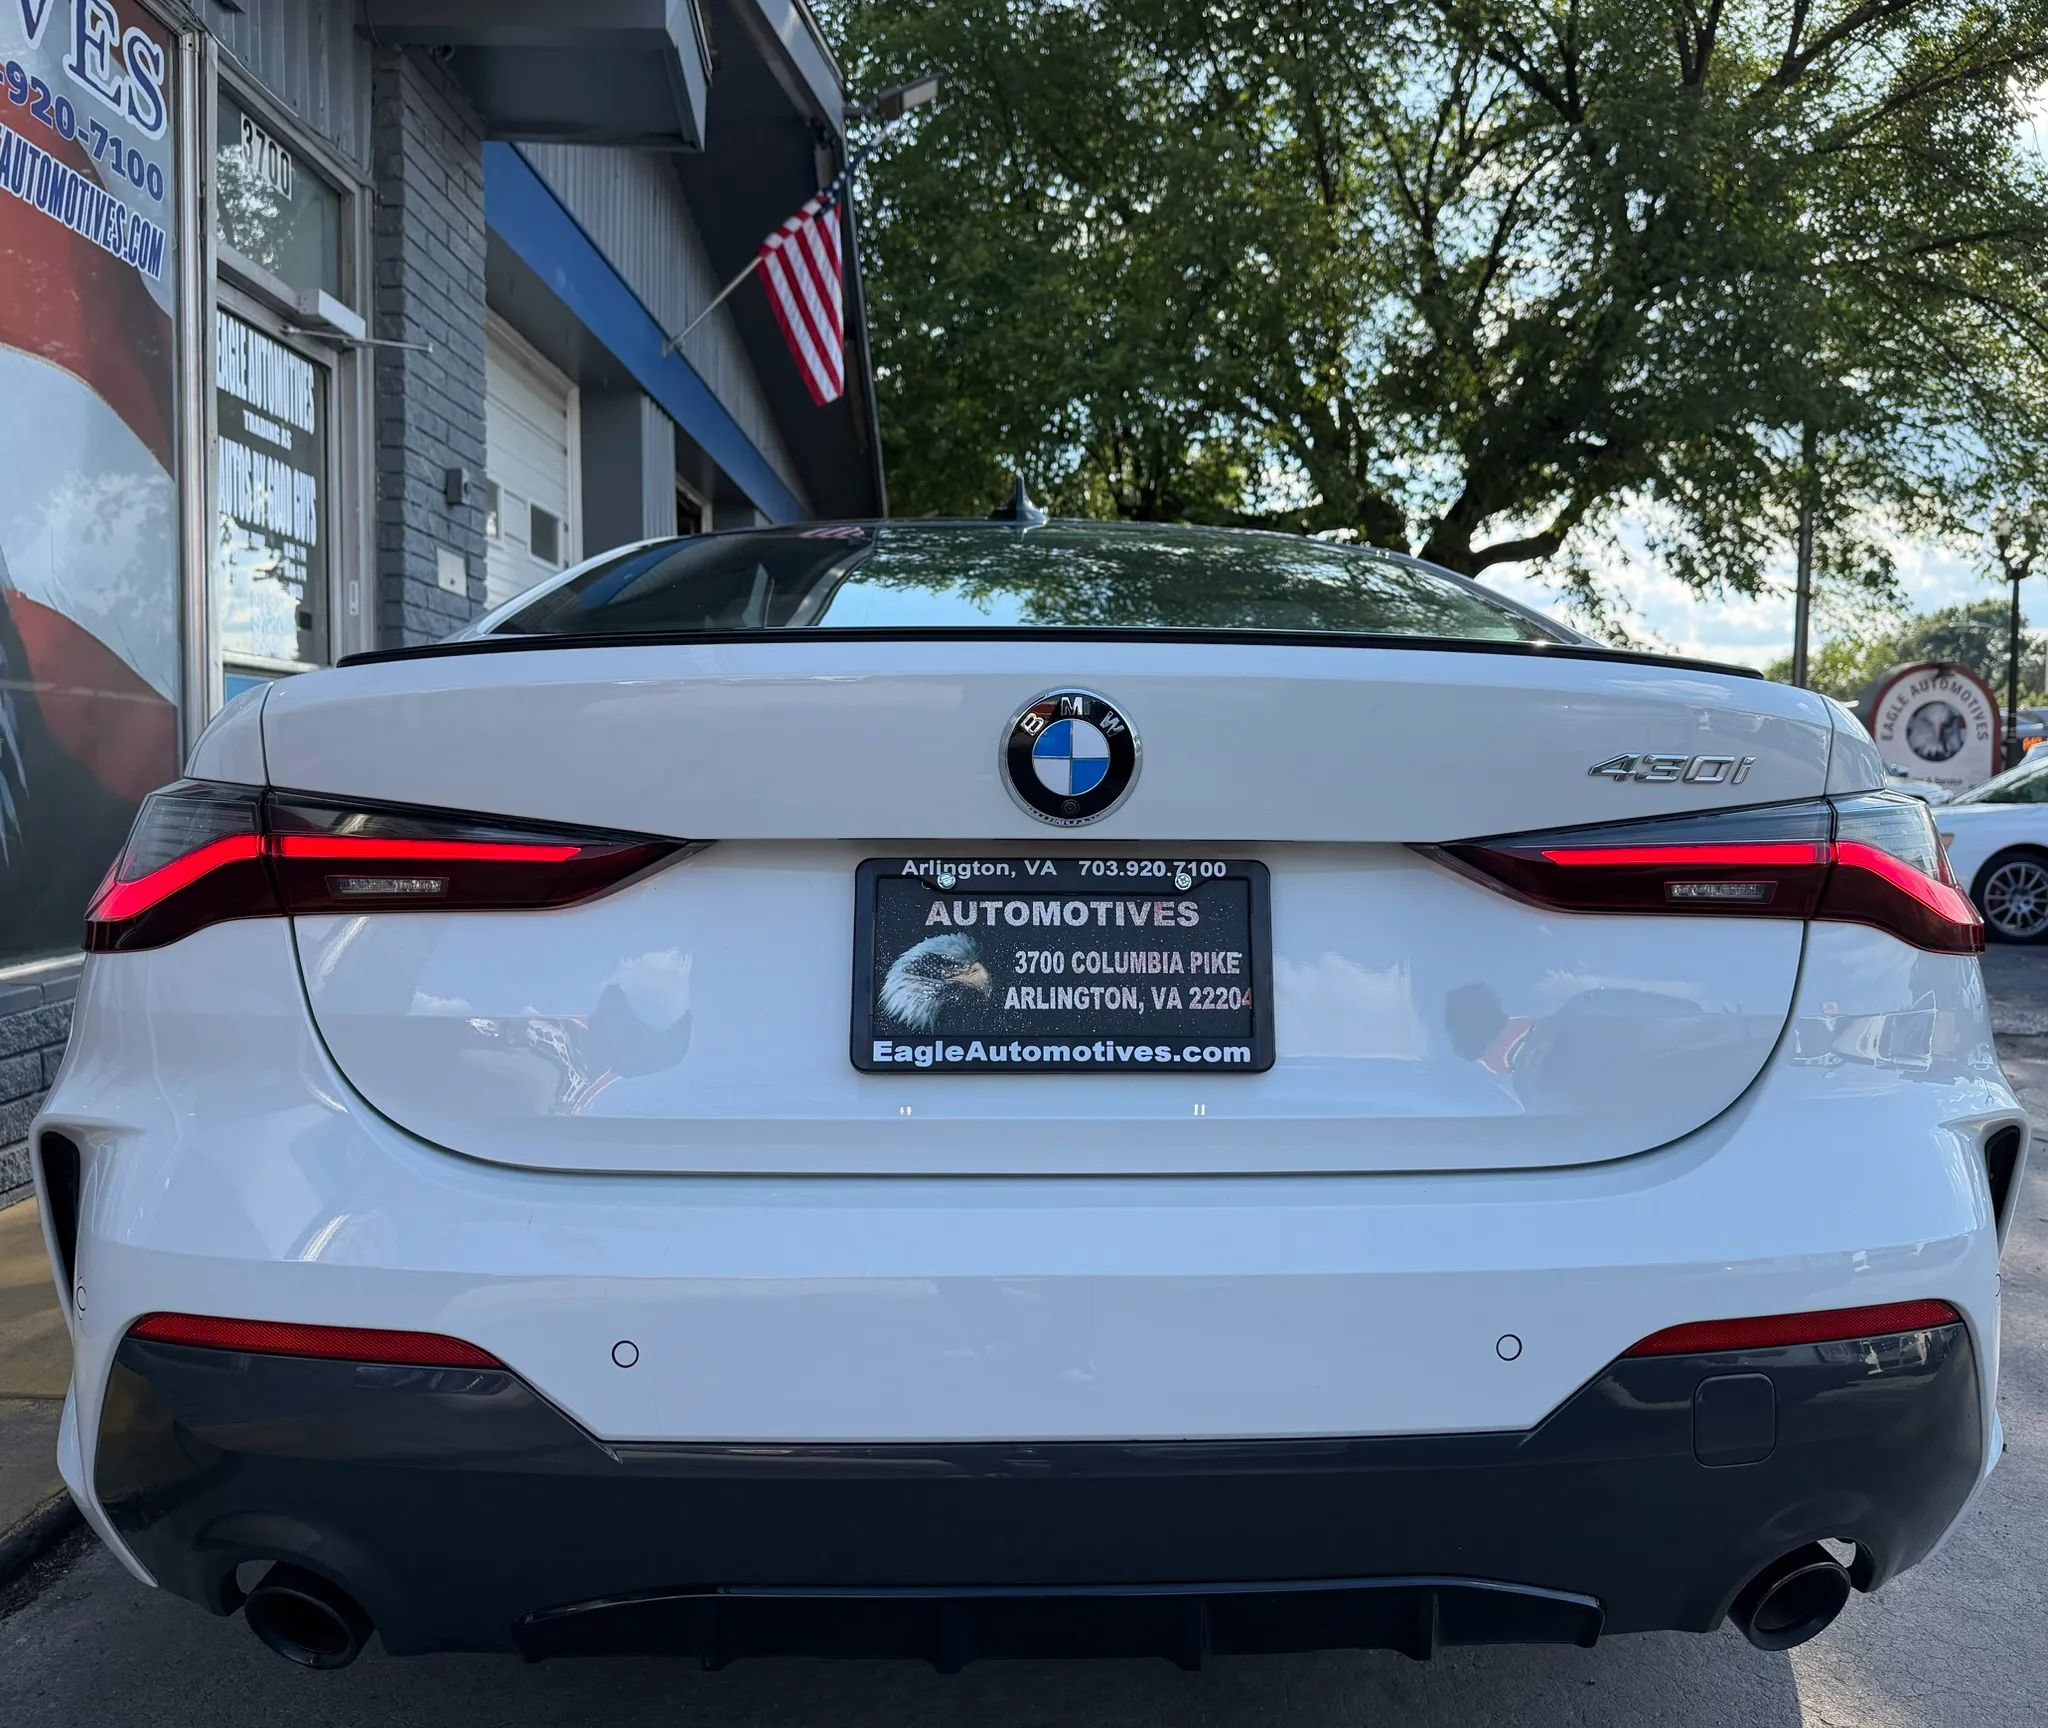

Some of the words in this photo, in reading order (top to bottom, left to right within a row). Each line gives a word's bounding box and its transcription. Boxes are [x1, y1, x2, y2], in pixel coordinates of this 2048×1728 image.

[242, 117, 291, 197] 3700
[0, 122, 166, 281] AUTOMOTIVES.COM
[216, 310, 247, 402] EAGLE
[248, 327, 315, 435] AUTOMOTIVES
[243, 408, 280, 446] TRADING
[281, 427, 292, 451] AS
[1020, 696, 1125, 738] BMW
[1879, 692, 1911, 742] EAGLE
[1909, 676, 1990, 742] AUTOMOTIVES
[1587, 752, 1756, 785] 430i
[901, 860, 1016, 879] Arlington,
[1024, 860, 1057, 876] VA
[1078, 860, 1227, 877] 703.920.7100
[924, 900, 1200, 927] AUTOMOTIVES
[1014, 951, 1065, 974] 3700
[1071, 951, 1184, 974] COLUMBIA
[1190, 952, 1243, 974] PIKE
[1004, 986, 1144, 1014] ARLINGTON,
[1151, 986, 1182, 1010] VA
[872, 1040, 1251, 1067] EagleAutomotives.com
